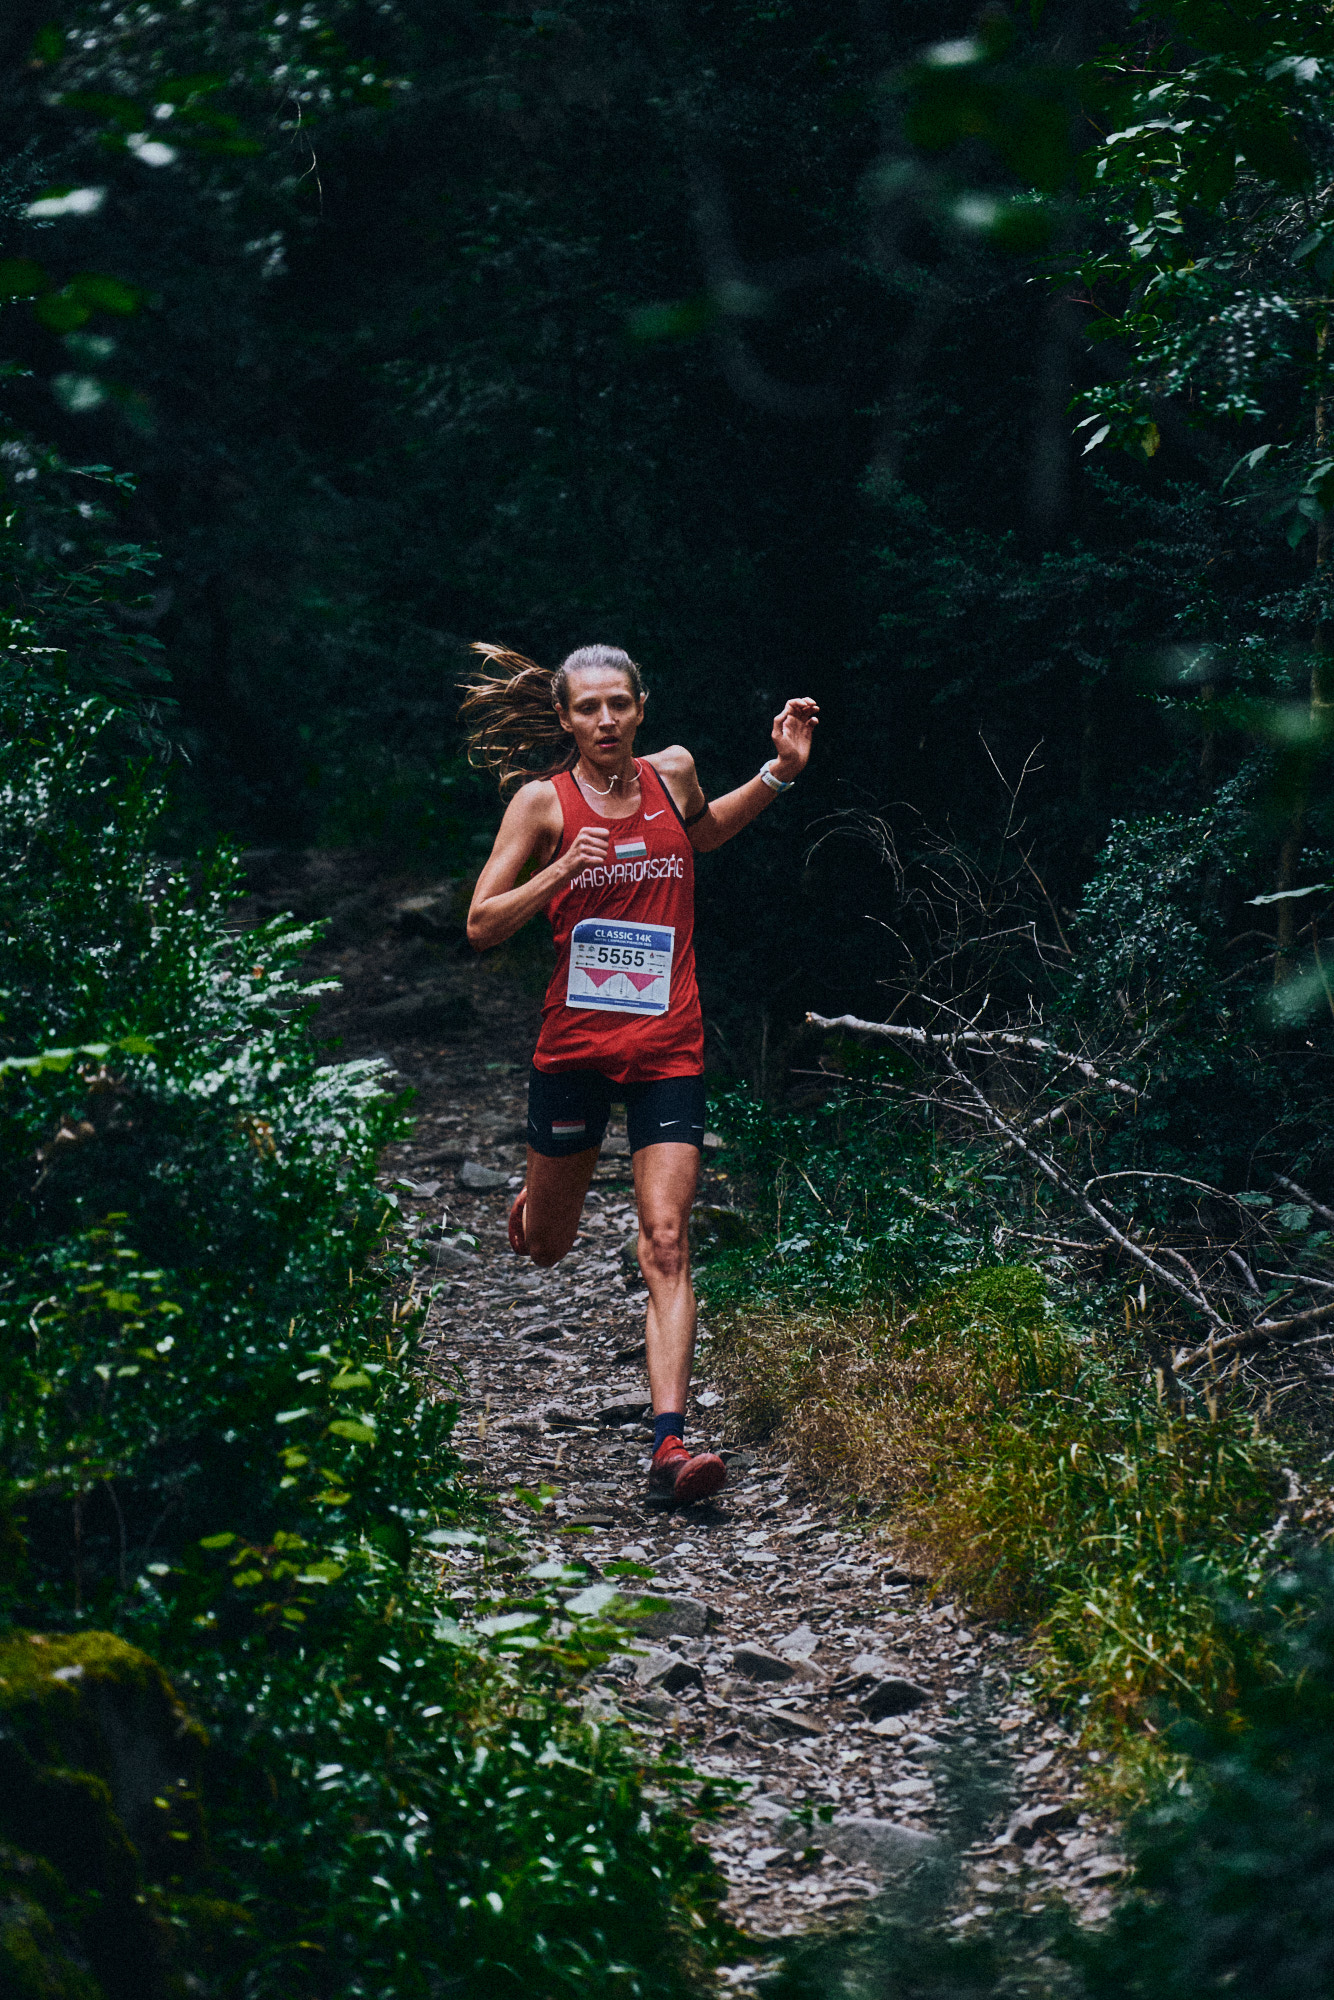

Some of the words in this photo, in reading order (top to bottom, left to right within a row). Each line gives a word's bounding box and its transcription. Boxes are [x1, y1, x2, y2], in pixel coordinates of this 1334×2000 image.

[570, 853, 684, 890] MAGYARORSZÁG
[594, 929, 634, 941] CLASSIC
[635, 933, 652, 943] 14K
[597, 946, 645, 967] 5555
